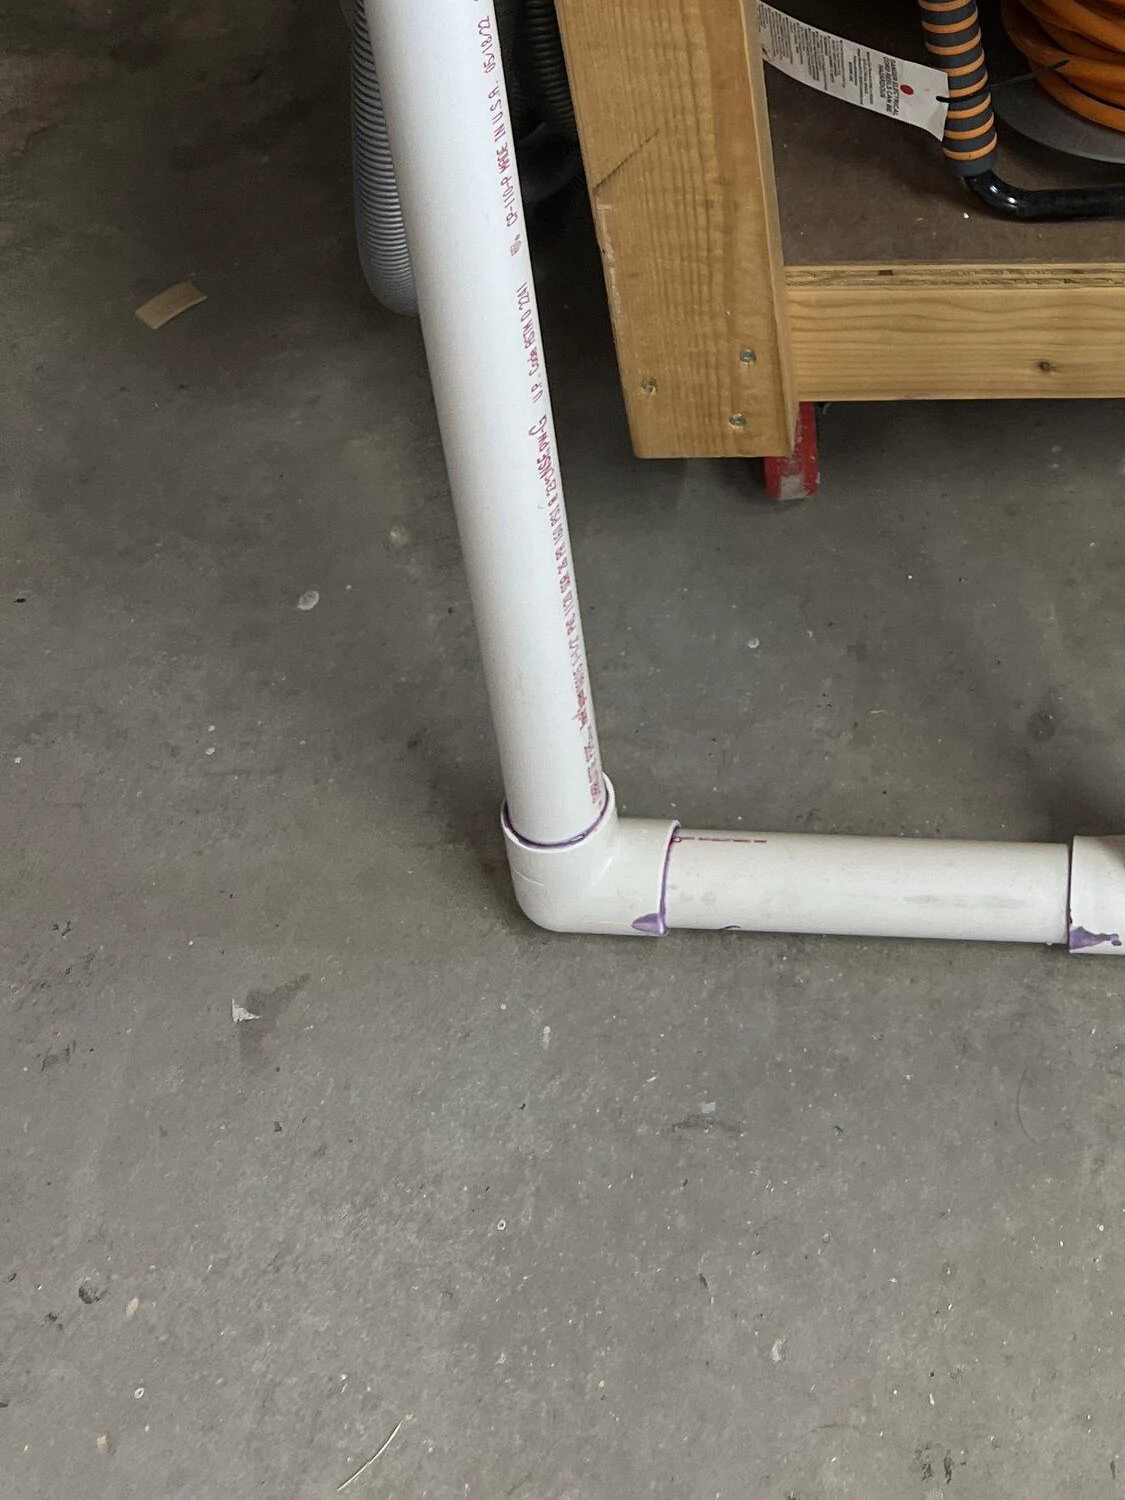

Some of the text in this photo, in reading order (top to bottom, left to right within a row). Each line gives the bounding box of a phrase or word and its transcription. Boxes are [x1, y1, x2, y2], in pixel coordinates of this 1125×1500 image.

[477, 15, 497, 74] 05/18/22
[488, 80, 503, 125] U.S.A.
[494, 123, 506, 143] IN
[496, 142, 510, 174] MADE
[500, 176, 518, 227] CP-110-P
